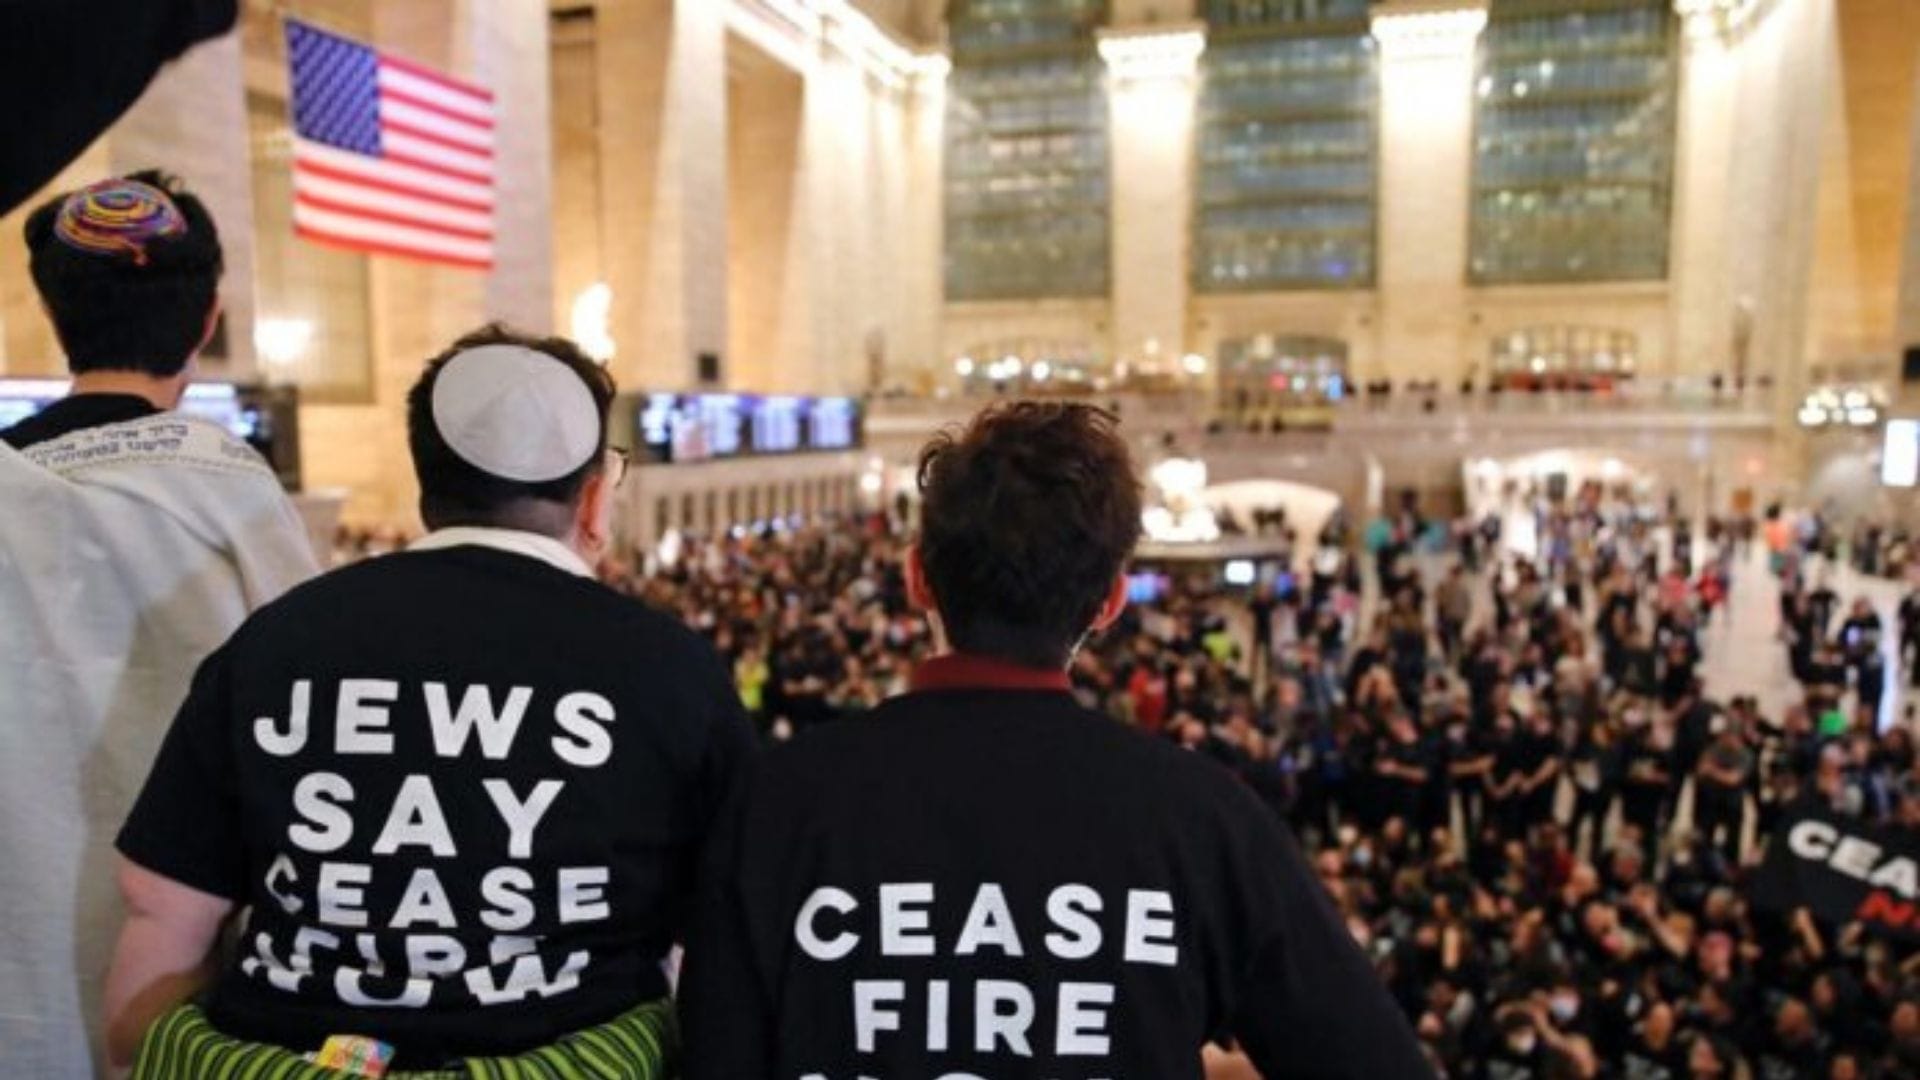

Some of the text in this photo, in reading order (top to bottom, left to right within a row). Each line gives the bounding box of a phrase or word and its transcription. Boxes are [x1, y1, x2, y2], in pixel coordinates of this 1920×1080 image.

[254, 679, 615, 766] JEWS
[289, 772, 564, 858] SAY
[266, 852, 609, 930] CEASE
[795, 883, 1178, 965] CEASE
[854, 980, 1114, 1056] FIRE
